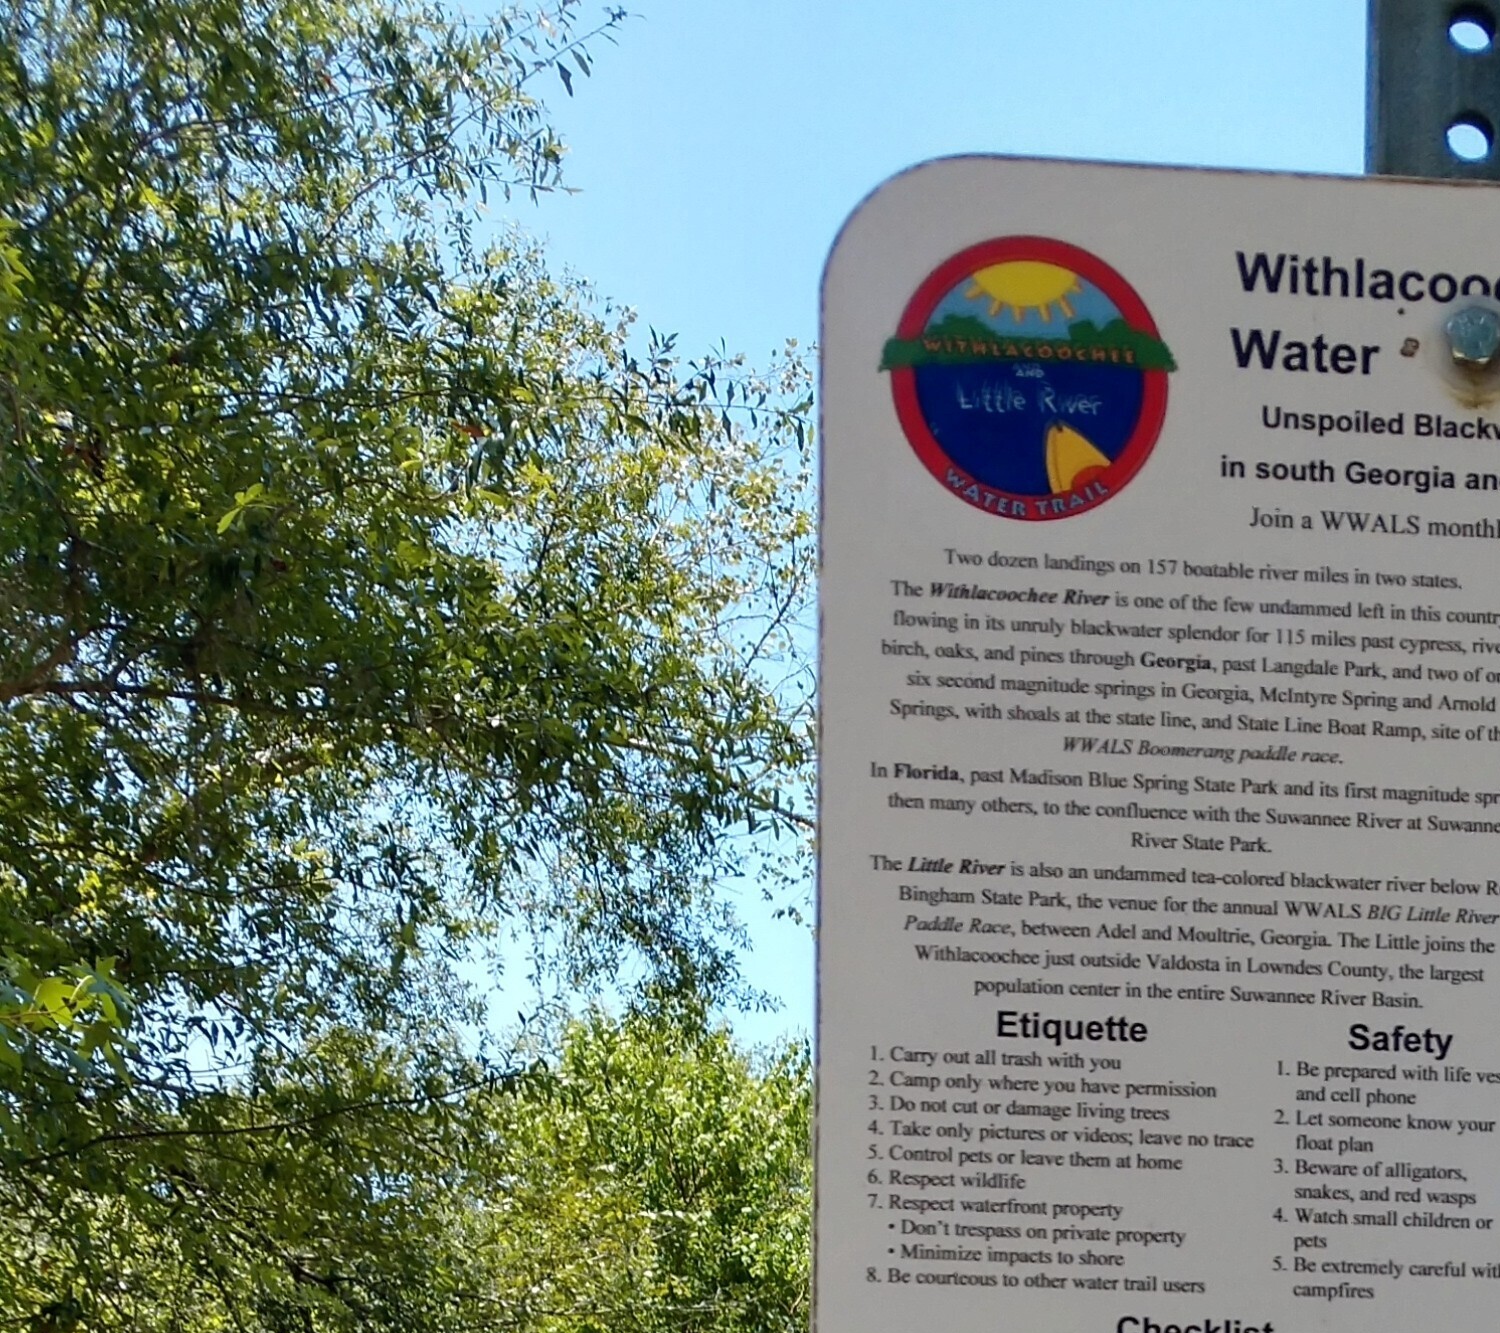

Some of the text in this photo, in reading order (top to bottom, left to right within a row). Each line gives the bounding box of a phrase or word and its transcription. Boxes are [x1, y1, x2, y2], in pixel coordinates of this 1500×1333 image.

[923, 338, 1136, 364] WITHLACOOCHEE
[1229, 327, 1381, 376] Water
[957, 385, 1103, 416] Little River
[1262, 405, 1405, 437] Unspoiled
[1221, 454, 1246, 479] in
[1255, 459, 1335, 483] south
[1345, 460, 1456, 494] Georgia
[946, 469, 1109, 516] WATER TRAIL
[1249, 506, 1294, 529] Join
[1300, 515, 1314, 530] a
[1320, 510, 1421, 535] WWALS
[943, 548, 1463, 590] Two dozen landings on 157 boatable river miles in two states.
[890, 579, 924, 598] The
[930, 581, 1059, 604] Withlacoochee
[1062, 588, 1111, 606] River
[1115, 590, 1129, 608] is
[1133, 596, 1165, 610] one
[1168, 593, 1190, 611] of
[1191, 594, 1218, 612] the
[1223, 595, 1254, 613] few
[1259, 599, 1352, 618] undammed
[1357, 602, 1386, 620] left
[1390, 603, 1406, 621] in
[1410, 605, 1442, 622] this
[996, 1010, 1148, 1047] Etiquette
[1348, 1023, 1454, 1061] Safety
[889, 1045, 938, 1068] Carry
[942, 1051, 970, 1065] out
[974, 1049, 997, 1066] all
[1000, 1050, 1043, 1068] trash
[1047, 1051, 1085, 1069] with
[1088, 1057, 1122, 1074] you
[1296, 1060, 1320, 1078] Be
[1323, 1064, 1397, 1083] prepared
[1401, 1064, 1439, 1082] with
[1444, 1066, 1472, 1083] life
[1295, 1086, 1417, 1108] and cell phone
